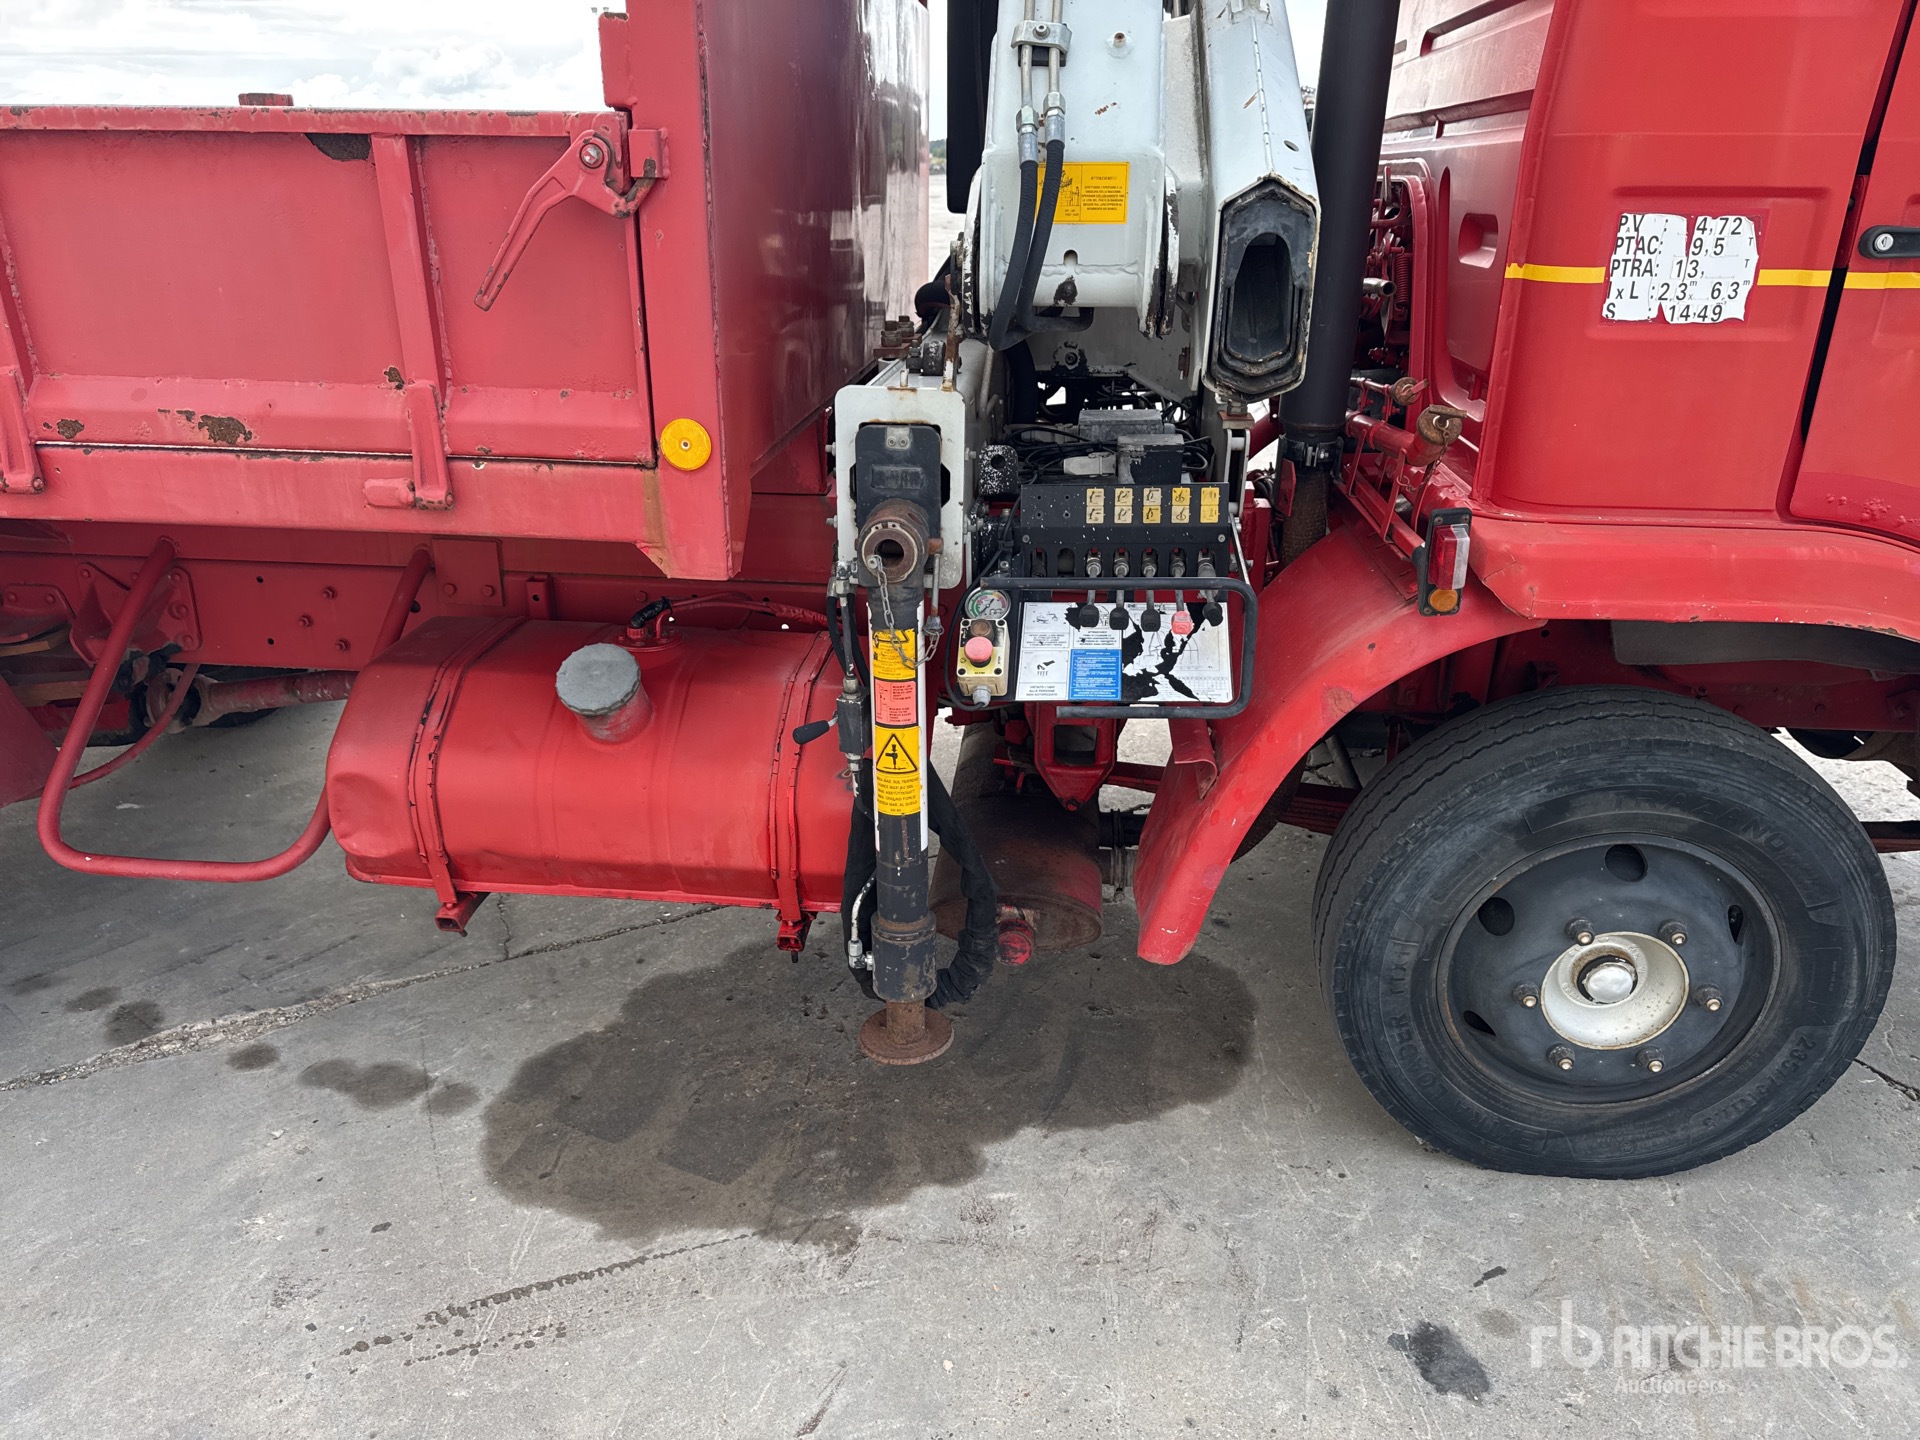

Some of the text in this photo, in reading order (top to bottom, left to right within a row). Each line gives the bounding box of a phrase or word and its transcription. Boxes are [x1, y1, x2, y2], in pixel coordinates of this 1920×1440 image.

[1696, 217, 1743, 236] 4,72
[1691, 237, 1725, 257] 9,5
[1676, 260, 1704, 279] 13,
[1629, 281, 1639, 299] L
[1605, 302, 1616, 319] S
[1669, 304, 1723, 322] 14,49
